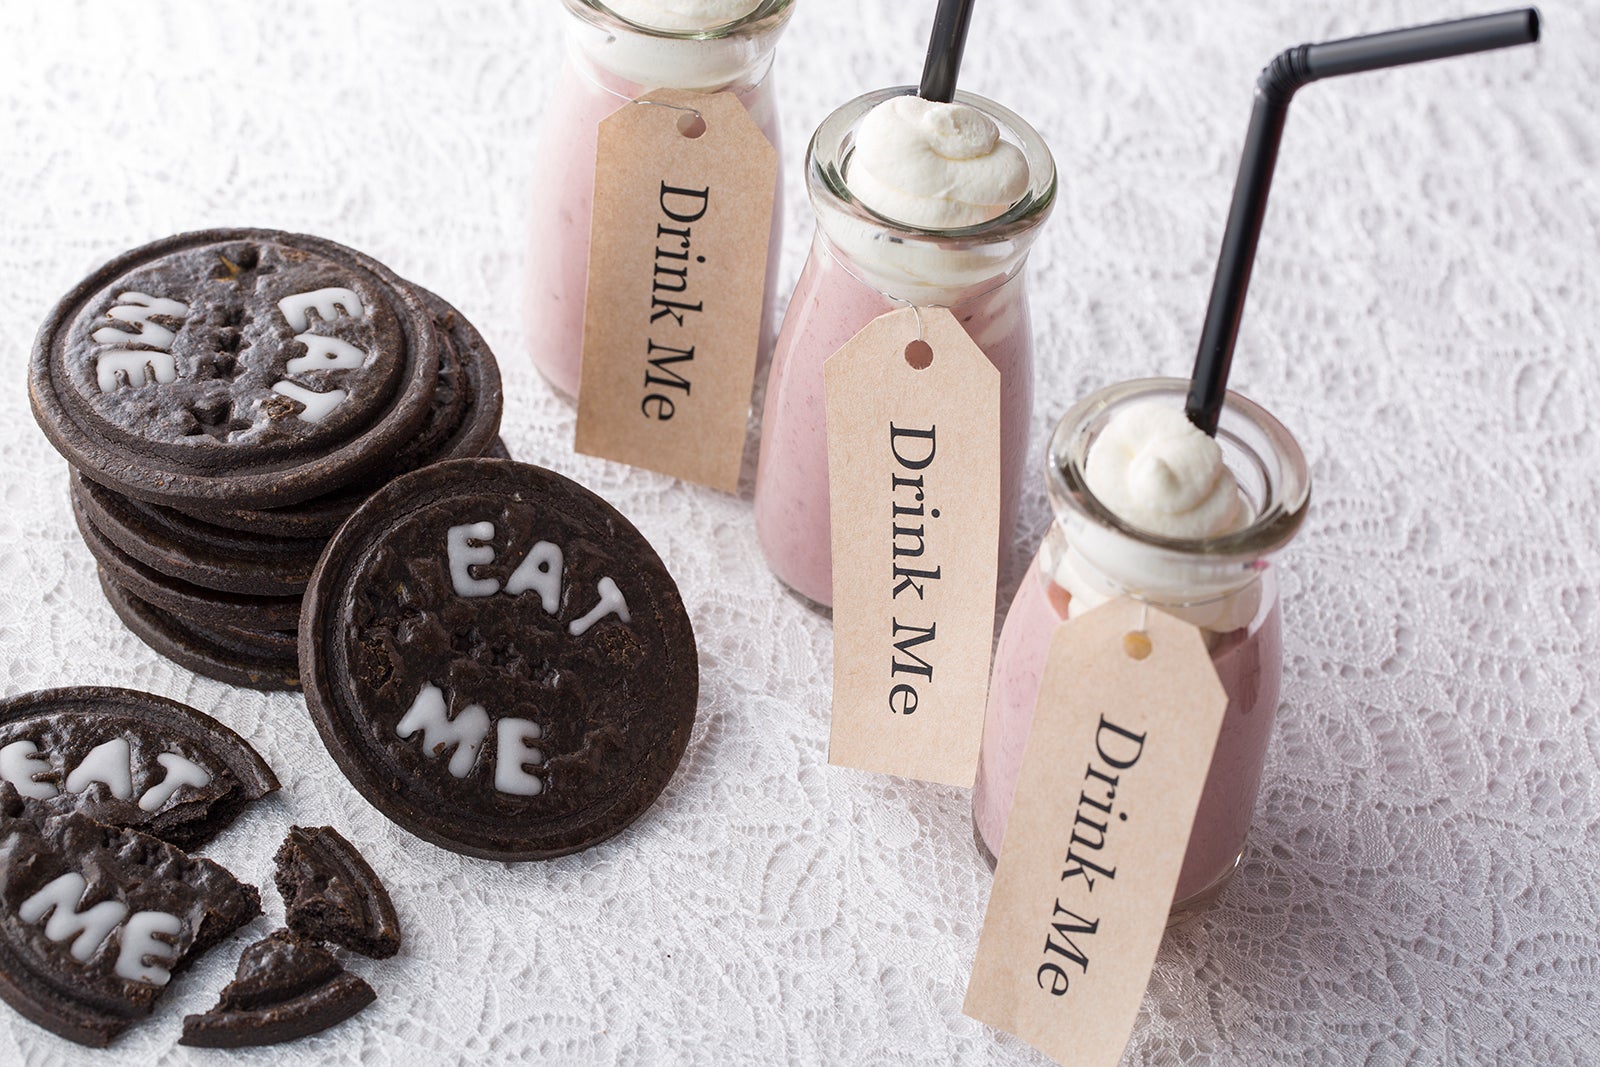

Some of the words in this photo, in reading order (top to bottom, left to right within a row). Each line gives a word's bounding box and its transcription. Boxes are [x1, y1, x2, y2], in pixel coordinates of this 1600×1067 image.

[649, 179, 709, 328] Drink
[92, 291, 189, 393] ME
[271, 286, 367, 423] EAT
[642, 338, 695, 421] Me
[889, 420, 942, 601] Drink
[446, 520, 632, 637] EAT
[888, 616, 937, 716] Me
[0, 736, 211, 813] EAT
[396, 681, 544, 796] ME
[1060, 712, 1147, 893] Drink
[19, 872, 182, 987] ME
[1036, 897, 1100, 998] Me
